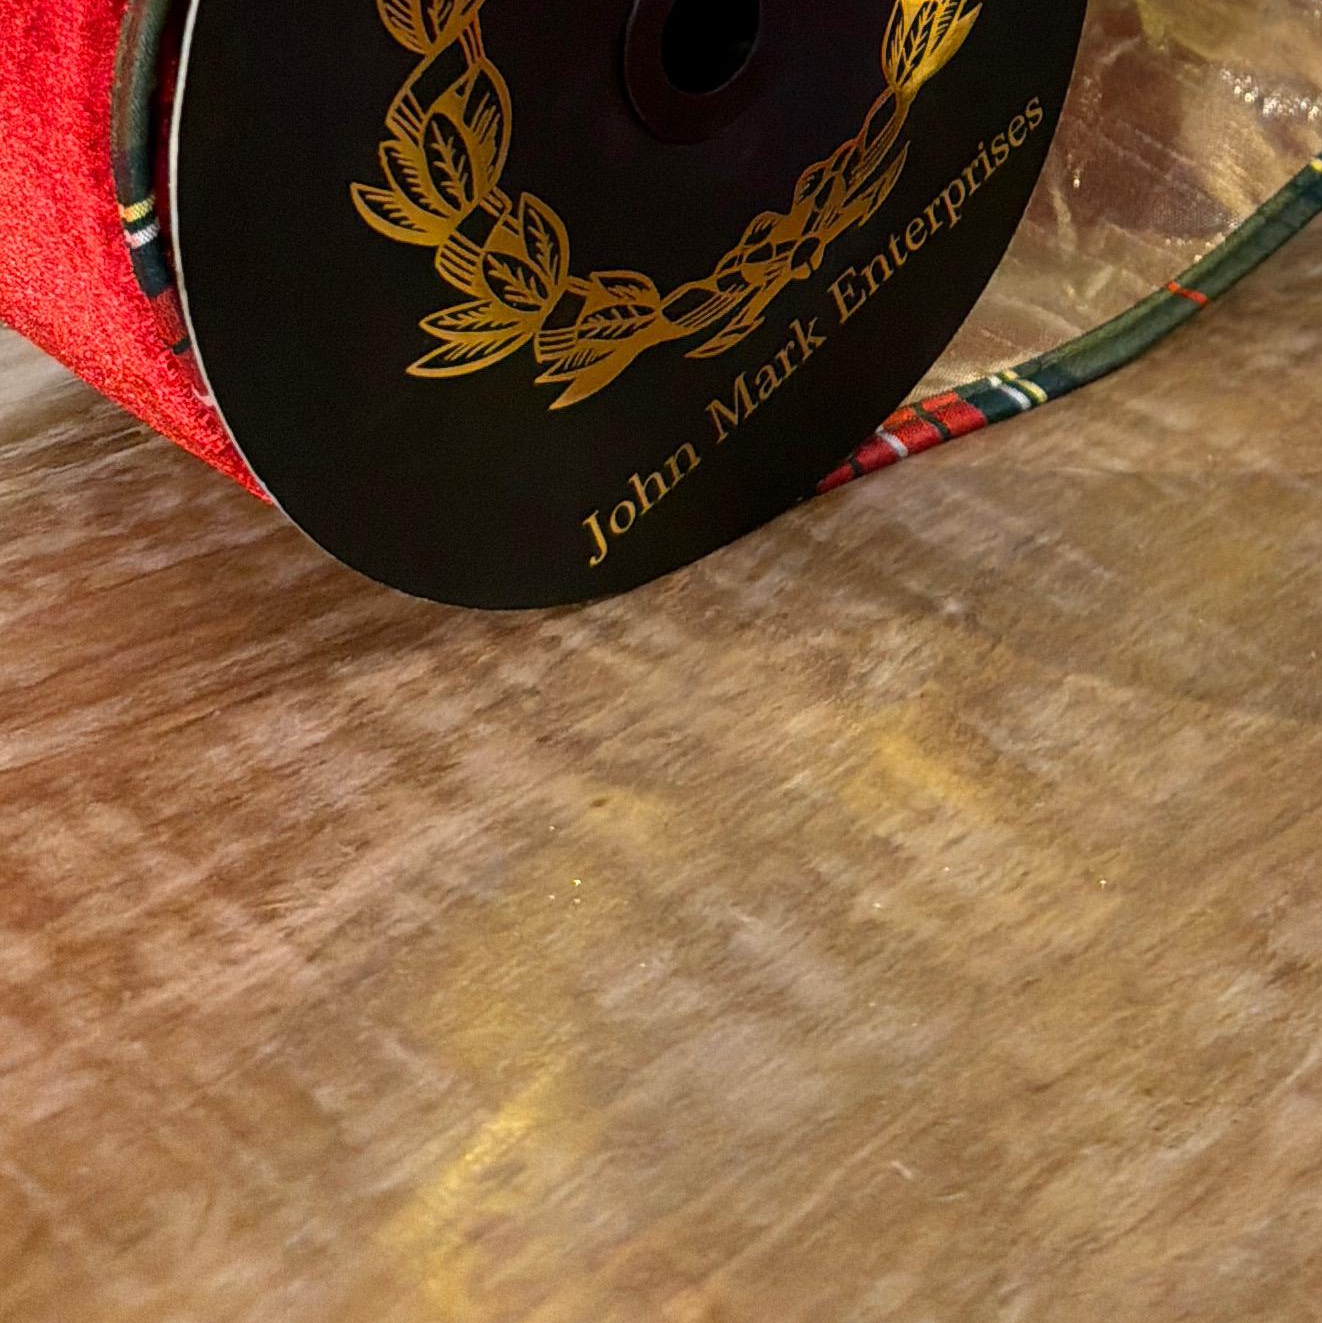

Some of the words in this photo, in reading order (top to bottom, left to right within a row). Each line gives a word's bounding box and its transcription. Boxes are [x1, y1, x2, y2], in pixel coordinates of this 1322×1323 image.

[582, 442, 700, 567] John
[705, 314, 827, 445] Mark
[826, 95, 1044, 325] Enterprises
